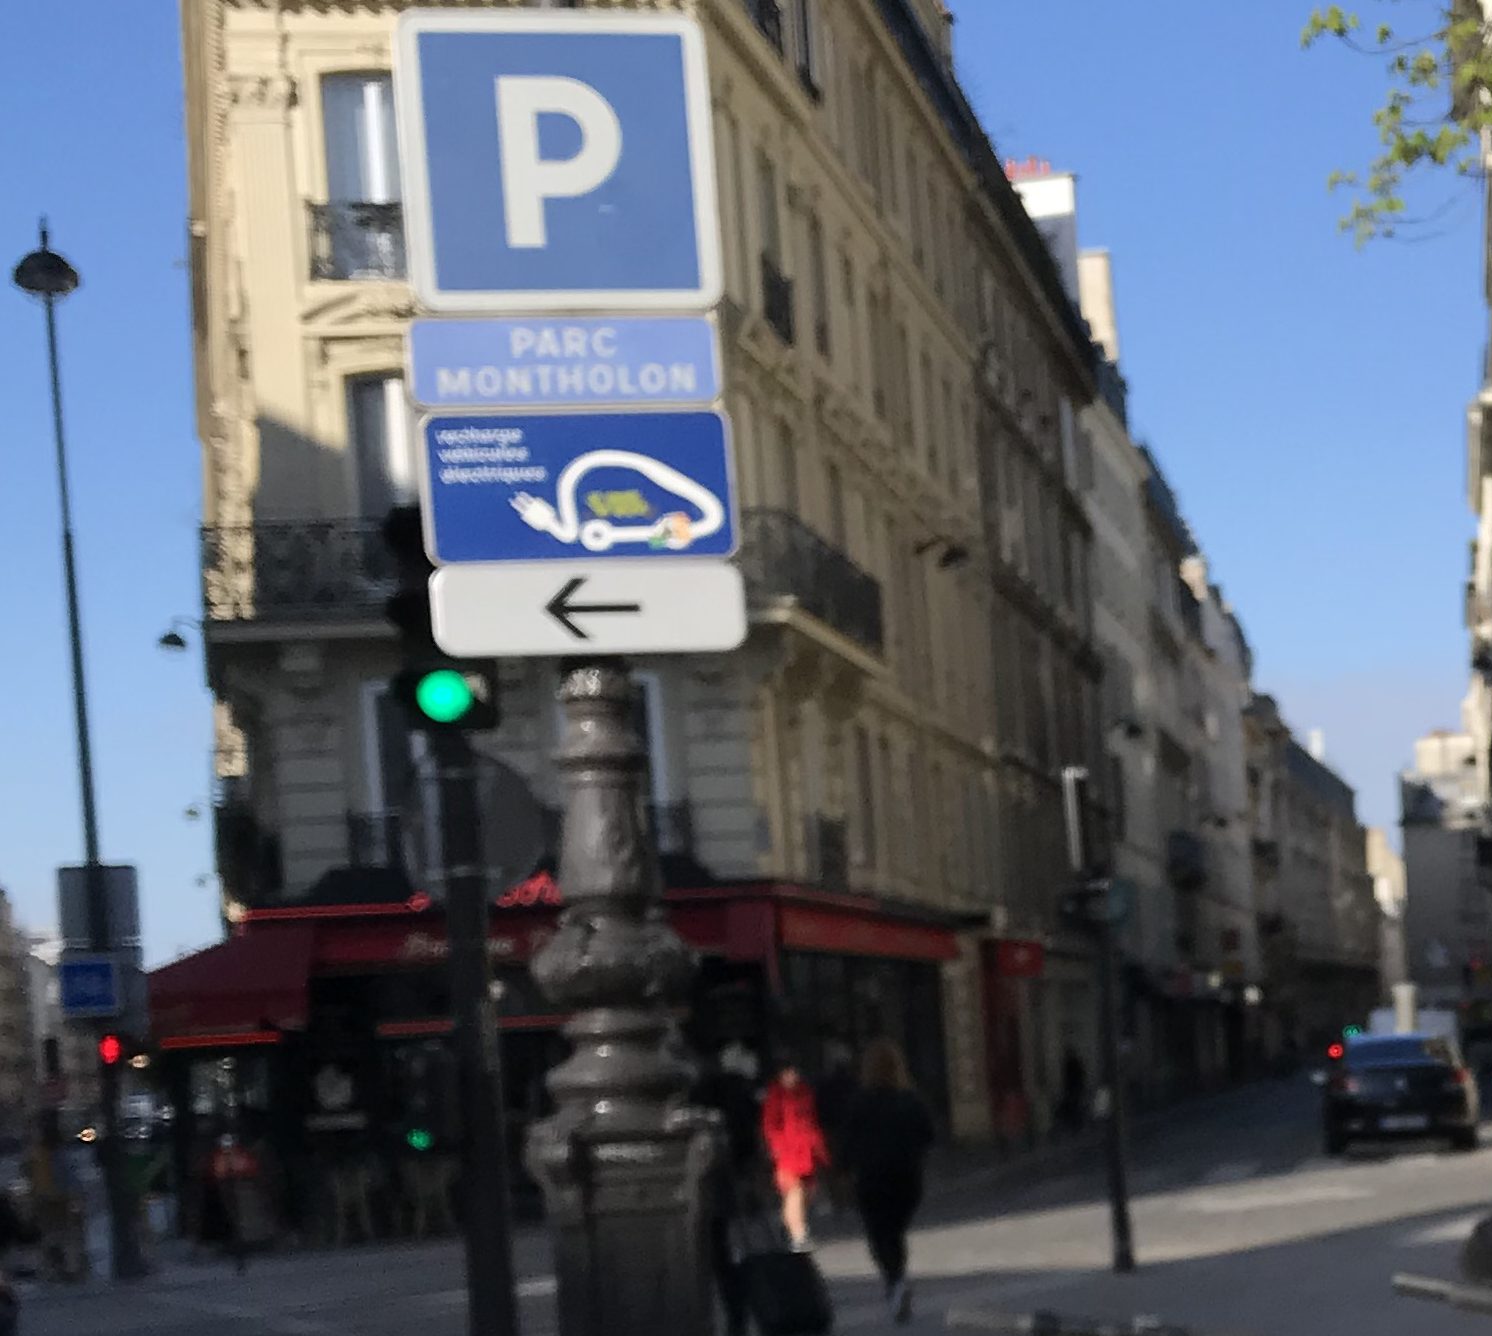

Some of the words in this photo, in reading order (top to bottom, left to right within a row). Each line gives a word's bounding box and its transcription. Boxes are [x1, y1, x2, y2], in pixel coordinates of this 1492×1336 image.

[495, 74, 623, 249] P
[509, 326, 619, 358] PARC
[436, 362, 697, 397] MONTHOLON
